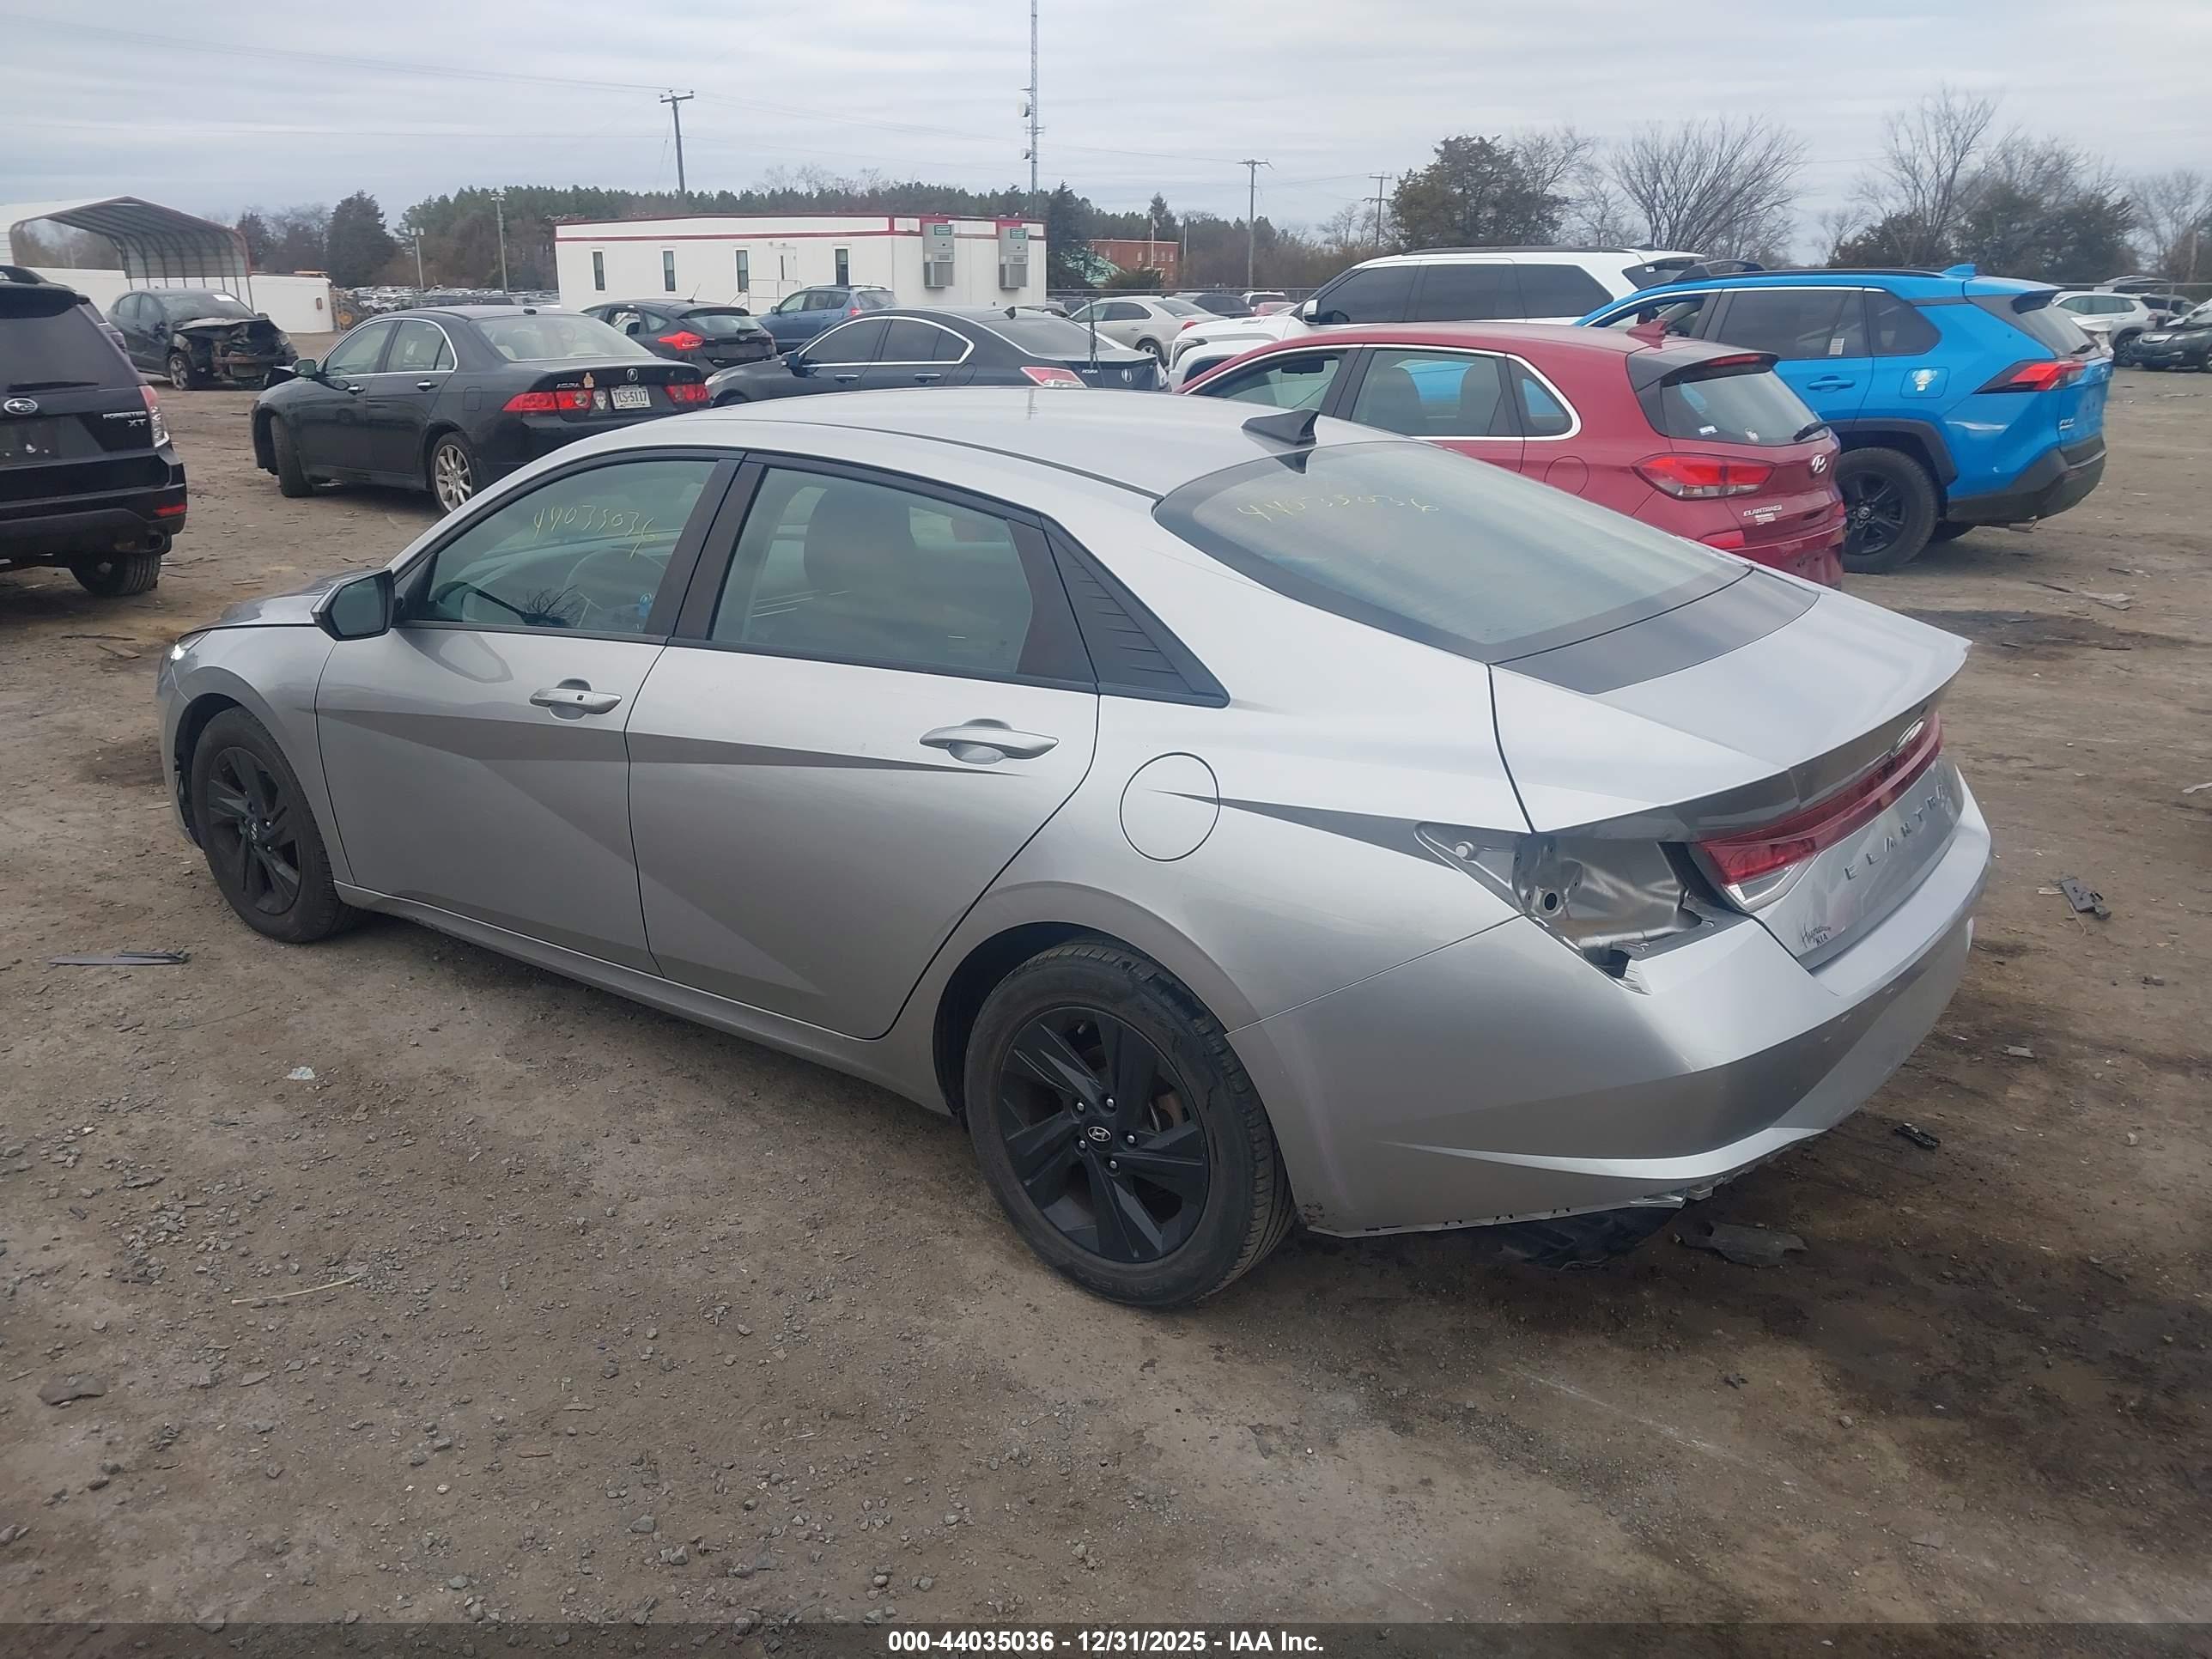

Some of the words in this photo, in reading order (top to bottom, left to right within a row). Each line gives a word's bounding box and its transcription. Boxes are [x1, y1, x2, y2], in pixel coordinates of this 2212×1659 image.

[614, 392, 647, 403] TCS-5117
[103, 410, 146, 419] FORESTER
[1844, 784, 1943, 880] ELANTRA
